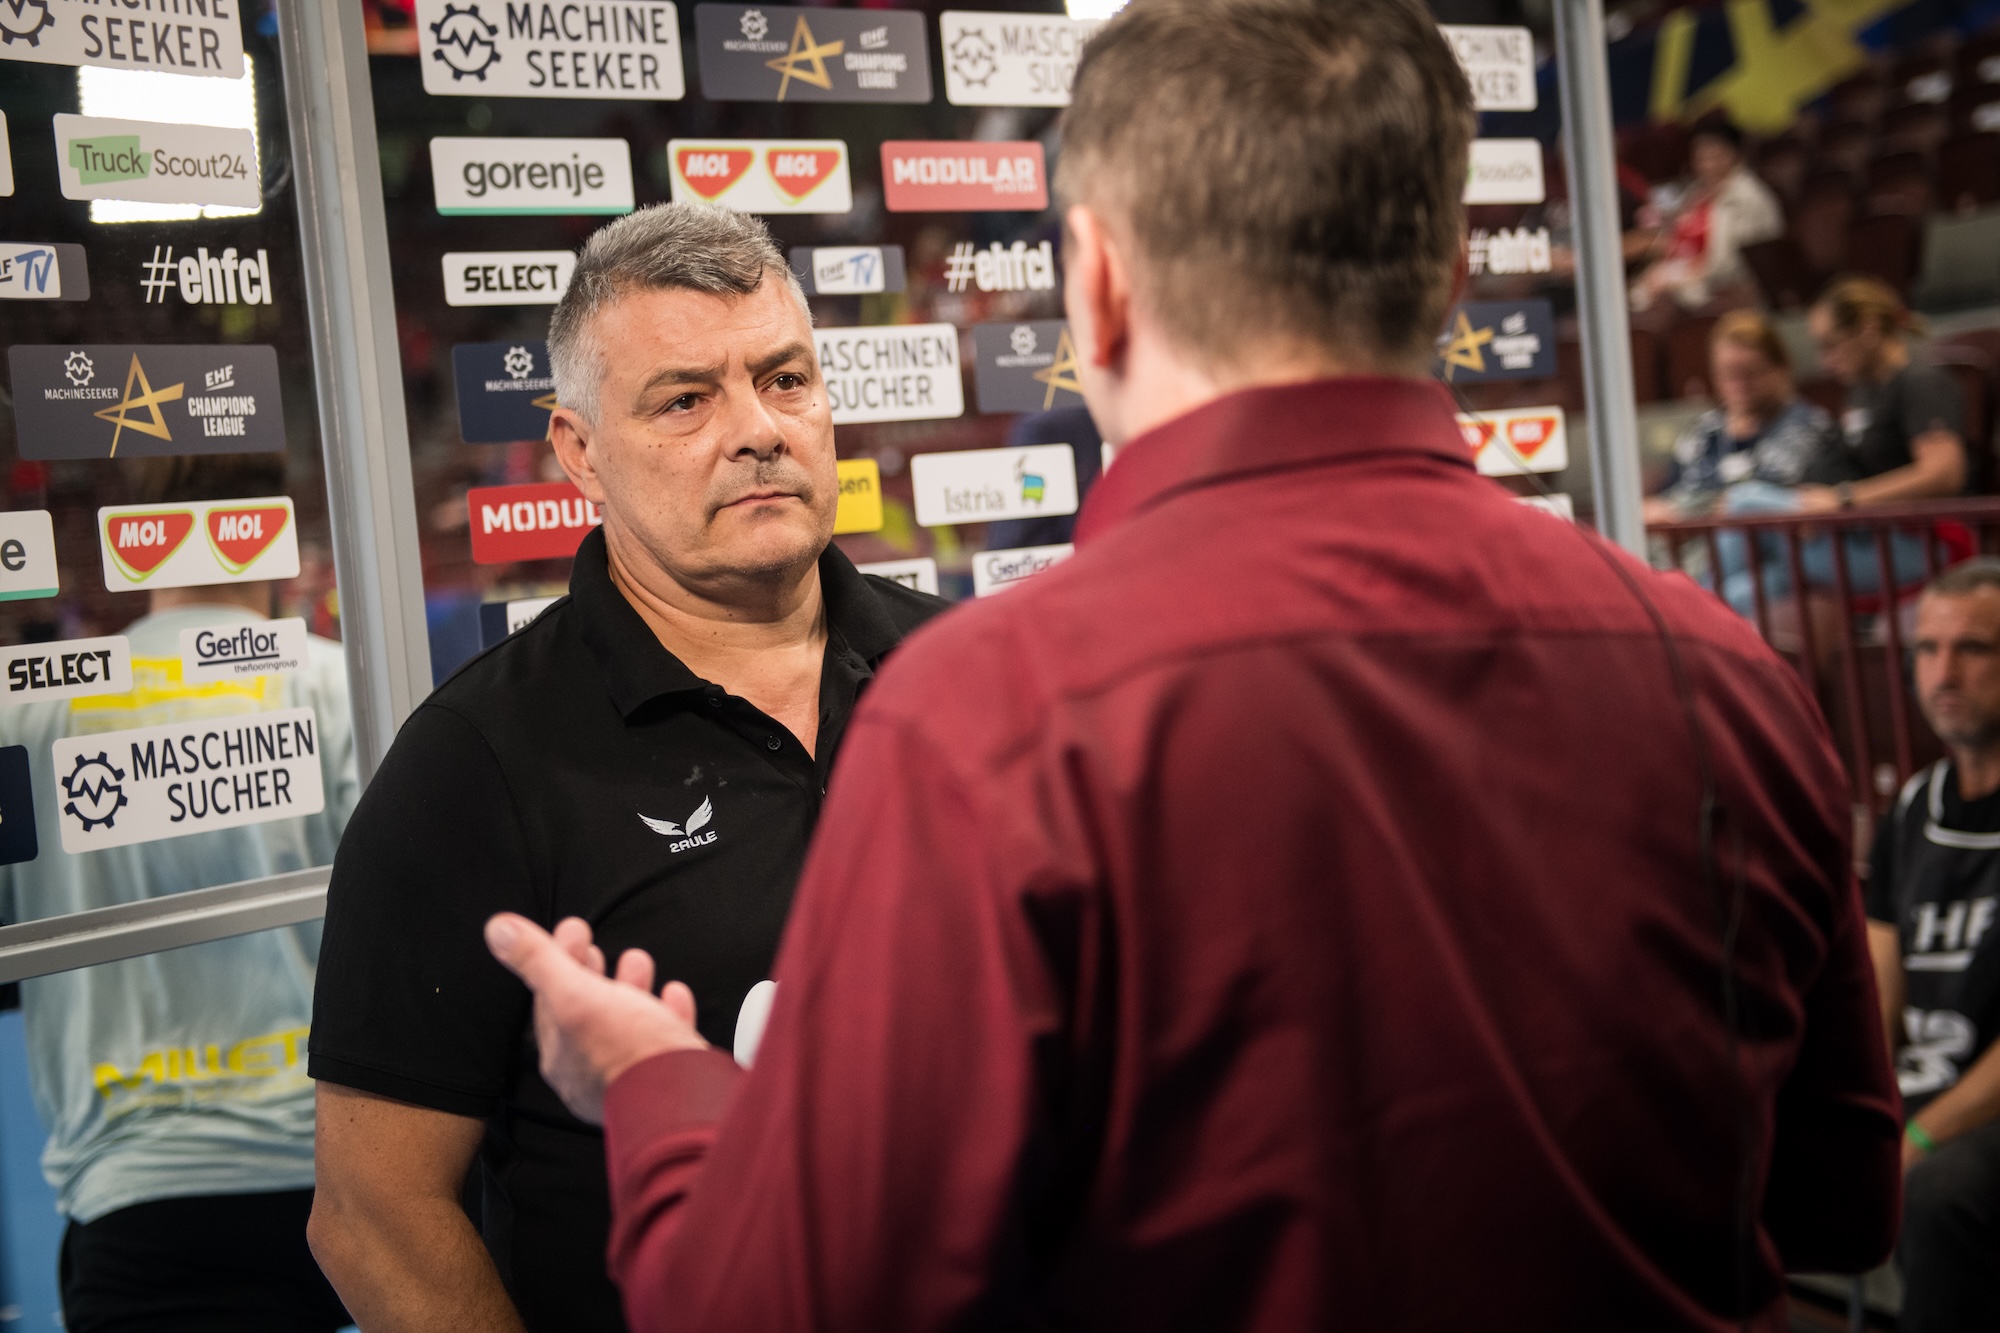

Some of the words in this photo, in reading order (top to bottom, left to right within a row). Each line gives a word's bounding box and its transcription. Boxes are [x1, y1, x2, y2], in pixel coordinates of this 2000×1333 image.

[506, 1, 669, 44] MACHINE
[81, 14, 222, 70] SEEKER
[526, 51, 661, 90] SEEKER
[1027, 62, 1074, 93] SUC
[463, 153, 604, 198] gorenje
[685, 154, 731, 178] MOL
[775, 154, 818, 178] MOL
[893, 156, 1036, 185] MODULAR
[140, 245, 272, 305] #ehfcl
[463, 264, 559, 293] SELECT
[944, 240, 1056, 292] #ehfcl
[819, 336, 954, 372] ASCHINEN
[44, 388, 119, 400] MACHINESEEKER
[205, 365, 234, 387] EHF
[826, 375, 934, 411] SUCHER
[187, 396, 256, 417] CHAMPIONS
[203, 416, 245, 437] LEAGUE
[481, 497, 603, 534] MODUL
[943, 486, 1009, 514] Istria
[118, 521, 168, 548] MOL
[217, 514, 263, 542] MOL
[195, 627, 280, 659] Gerflor
[8, 650, 112, 692] SELECT
[130, 719, 315, 782] MASCHINEN
[167, 768, 292, 822] SUCHER
